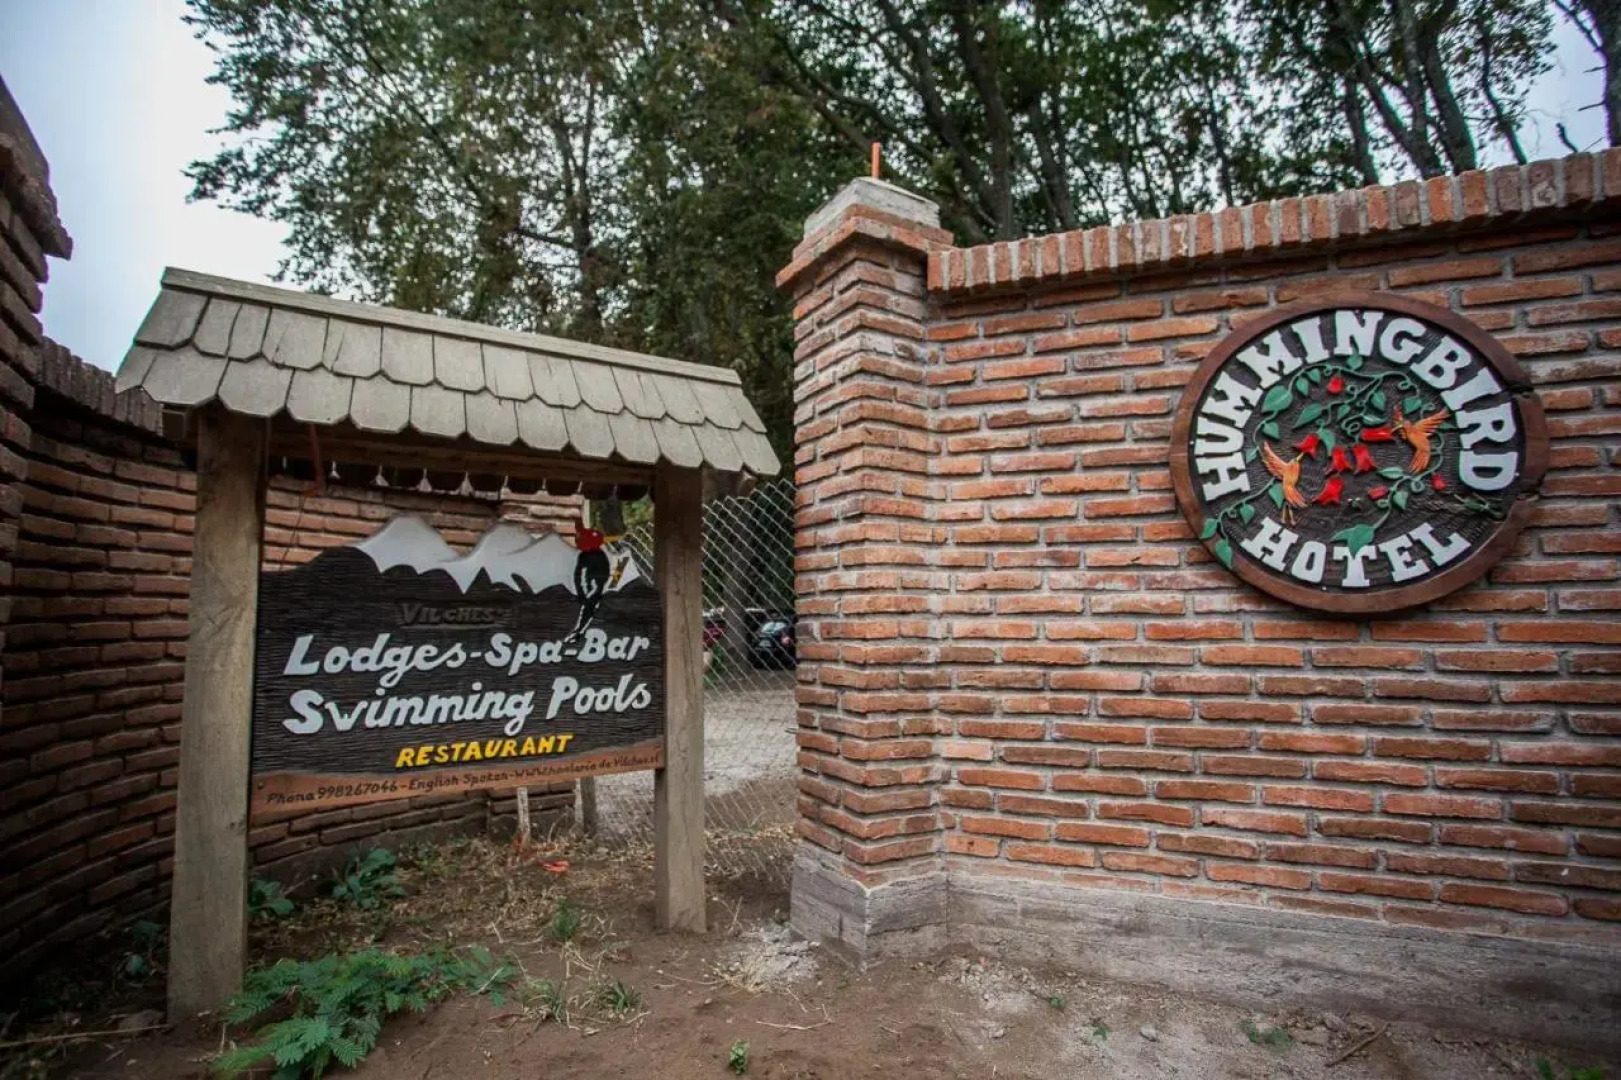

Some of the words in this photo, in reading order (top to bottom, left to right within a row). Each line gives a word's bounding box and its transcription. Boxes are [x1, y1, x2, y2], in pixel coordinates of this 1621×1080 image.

[1194, 310, 1518, 501] HUMMINGBIRD
[1240, 516, 1471, 588] HOTEL
[282, 688, 535, 736] Swimming
[545, 673, 652, 720] Pools
[394, 733, 574, 768] RESTAURANT
